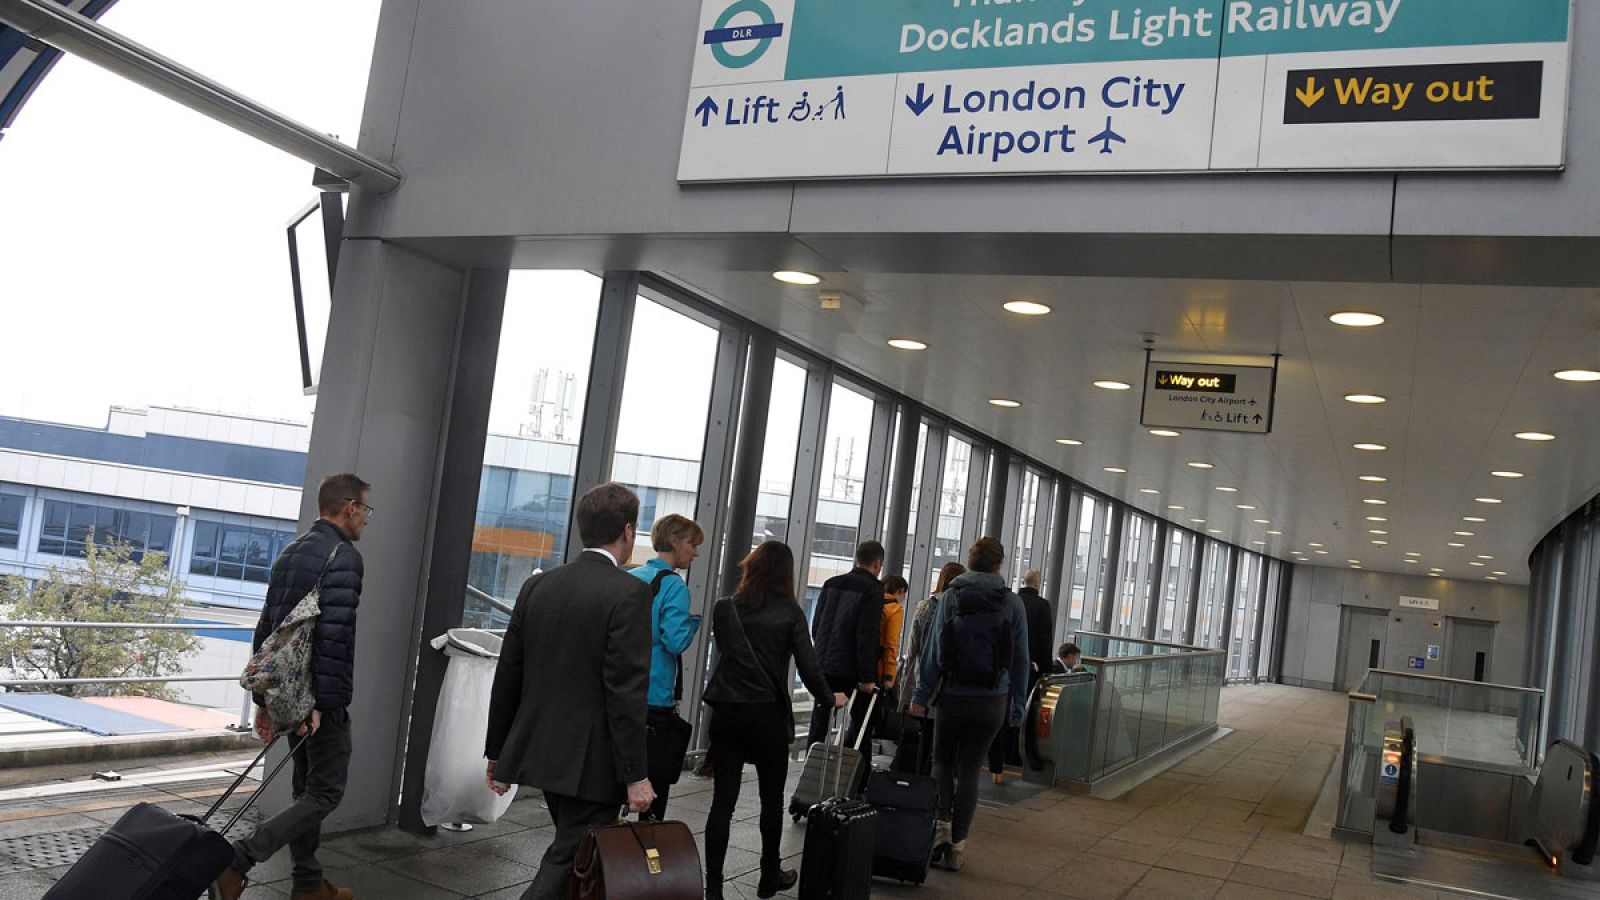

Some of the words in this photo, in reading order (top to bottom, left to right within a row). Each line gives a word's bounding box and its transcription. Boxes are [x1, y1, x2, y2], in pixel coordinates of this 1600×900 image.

[732, 28, 753, 39] DLR
[900, 13, 1095, 53] Docklands
[1108, 8, 1213, 46] Light
[1227, 0, 1401, 34] Railway
[942, 80, 1086, 114] London
[1101, 76, 1186, 115] City
[1334, 75, 1415, 110] Way
[1425, 75, 1495, 103] out
[725, 95, 780, 126] Lift
[936, 124, 1077, 162] Airport
[1170, 375, 1195, 388] Way
[1197, 376, 1220, 388] out
[1168, 394, 1198, 403] London
[1200, 396, 1216, 405] City
[1218, 397, 1246, 406] Airport
[1226, 412, 1249, 424] Lift
